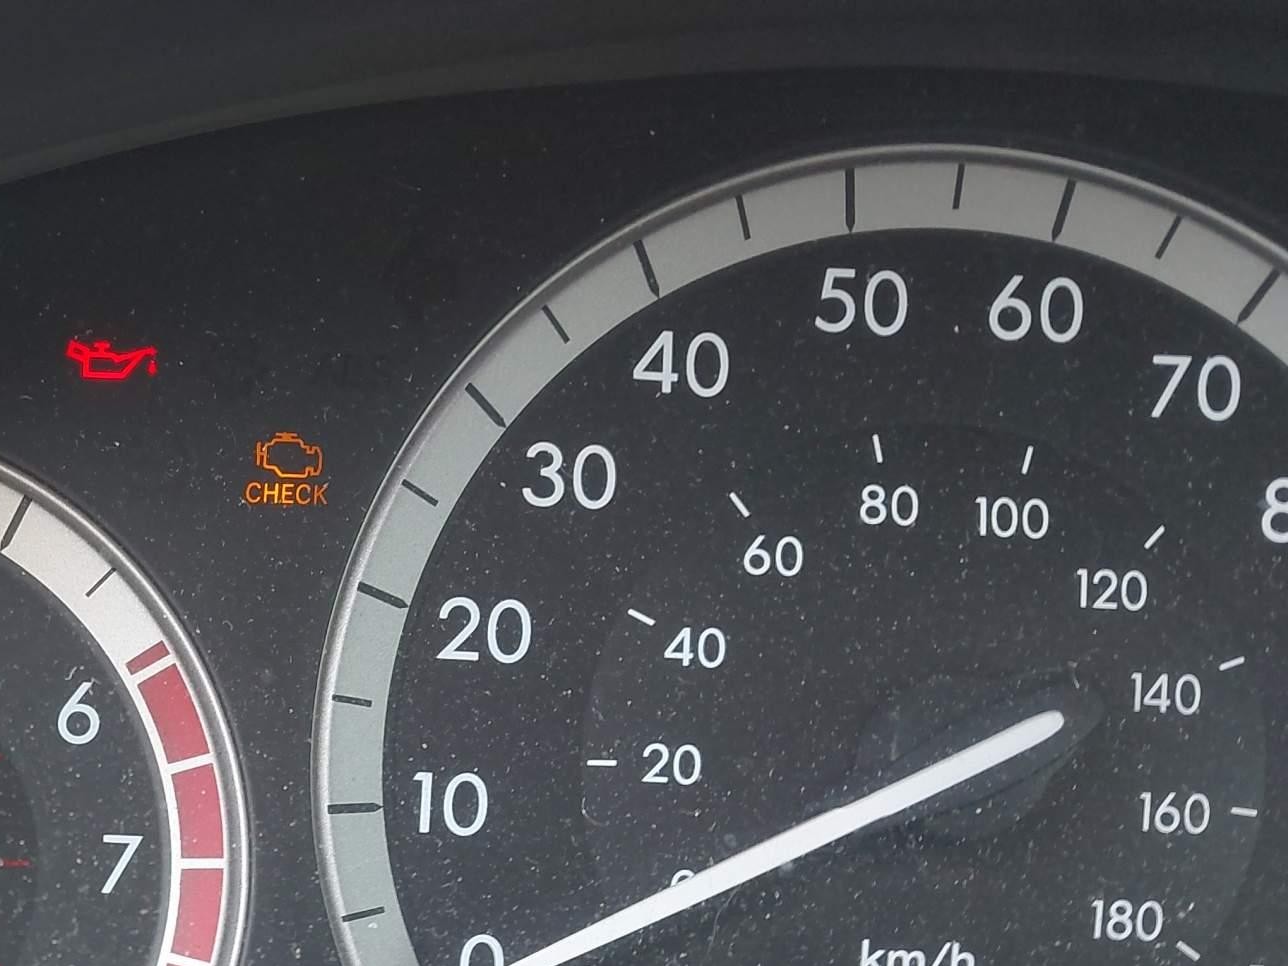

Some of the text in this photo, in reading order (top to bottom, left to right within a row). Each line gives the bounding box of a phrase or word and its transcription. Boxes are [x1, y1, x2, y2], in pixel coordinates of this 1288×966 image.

[815, 268, 907, 336] 50
[989, 275, 1083, 342] 60
[633, 331, 728, 397] 40
[1152, 355, 1240, 421] 70
[246, 482, 328, 505] CHECK
[522, 442, 616, 509] 30
[860, 485, 918, 526] 80
[976, 497, 1048, 539] 100
[744, 535, 803, 576] 60
[1077, 569, 1147, 611] 120
[436, 597, 531, 663] 20
[664, 628, 725, 668] 40
[58, 680, 100, 744] 6
[1131, 673, 1200, 715] 140
[642, 743, 701, 785] 20
[413, 772, 487, 836] 10
[1140, 792, 1210, 834] 160
[101, 835, 143, 893] 7
[1092, 900, 1163, 941] 180
